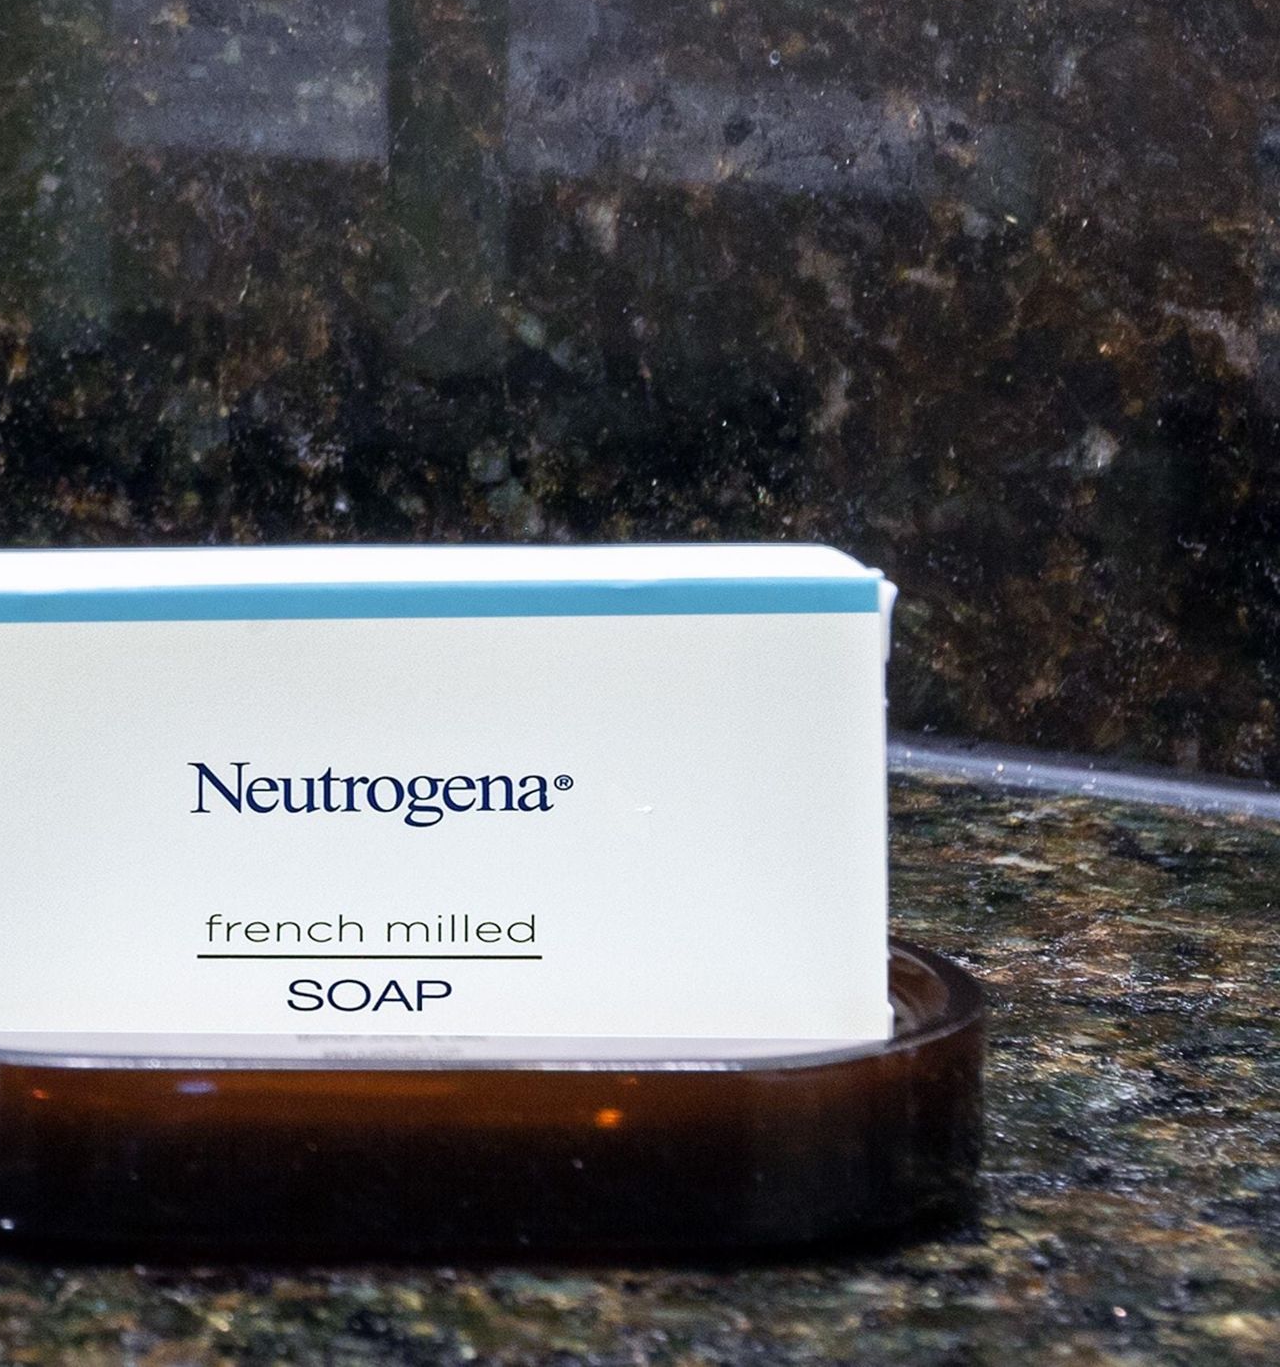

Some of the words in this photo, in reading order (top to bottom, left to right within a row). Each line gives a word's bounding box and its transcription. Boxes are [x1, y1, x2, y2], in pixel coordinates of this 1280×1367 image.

[205, 914, 363, 944] french
[387, 914, 536, 944] milled
[287, 979, 452, 1012] SOAP
